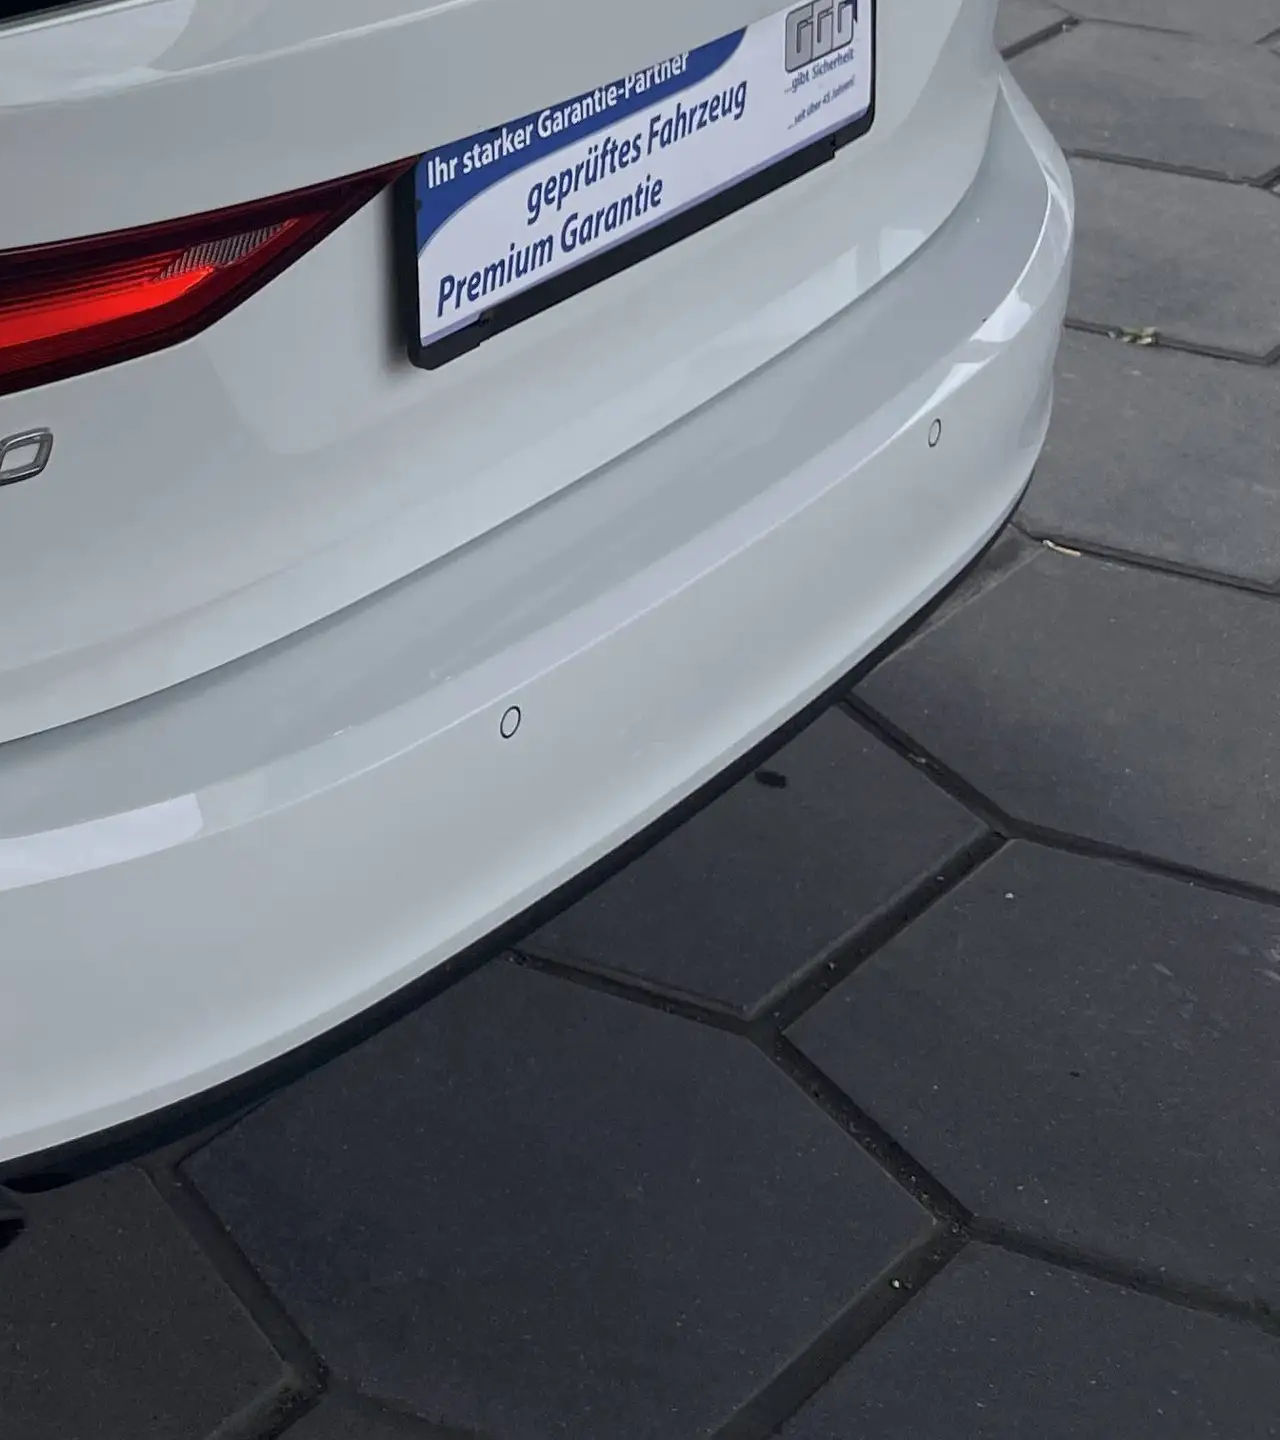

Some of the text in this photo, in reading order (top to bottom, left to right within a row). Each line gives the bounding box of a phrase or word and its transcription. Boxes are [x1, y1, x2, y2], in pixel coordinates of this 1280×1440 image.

[427, 51, 689, 189] Ihr starker Garantie-Partner
[811, 48, 854, 79] Sicherheit
[526, 80, 748, 226] geprüftes Fahrzeug
[437, 173, 664, 319] Premium Garantie
